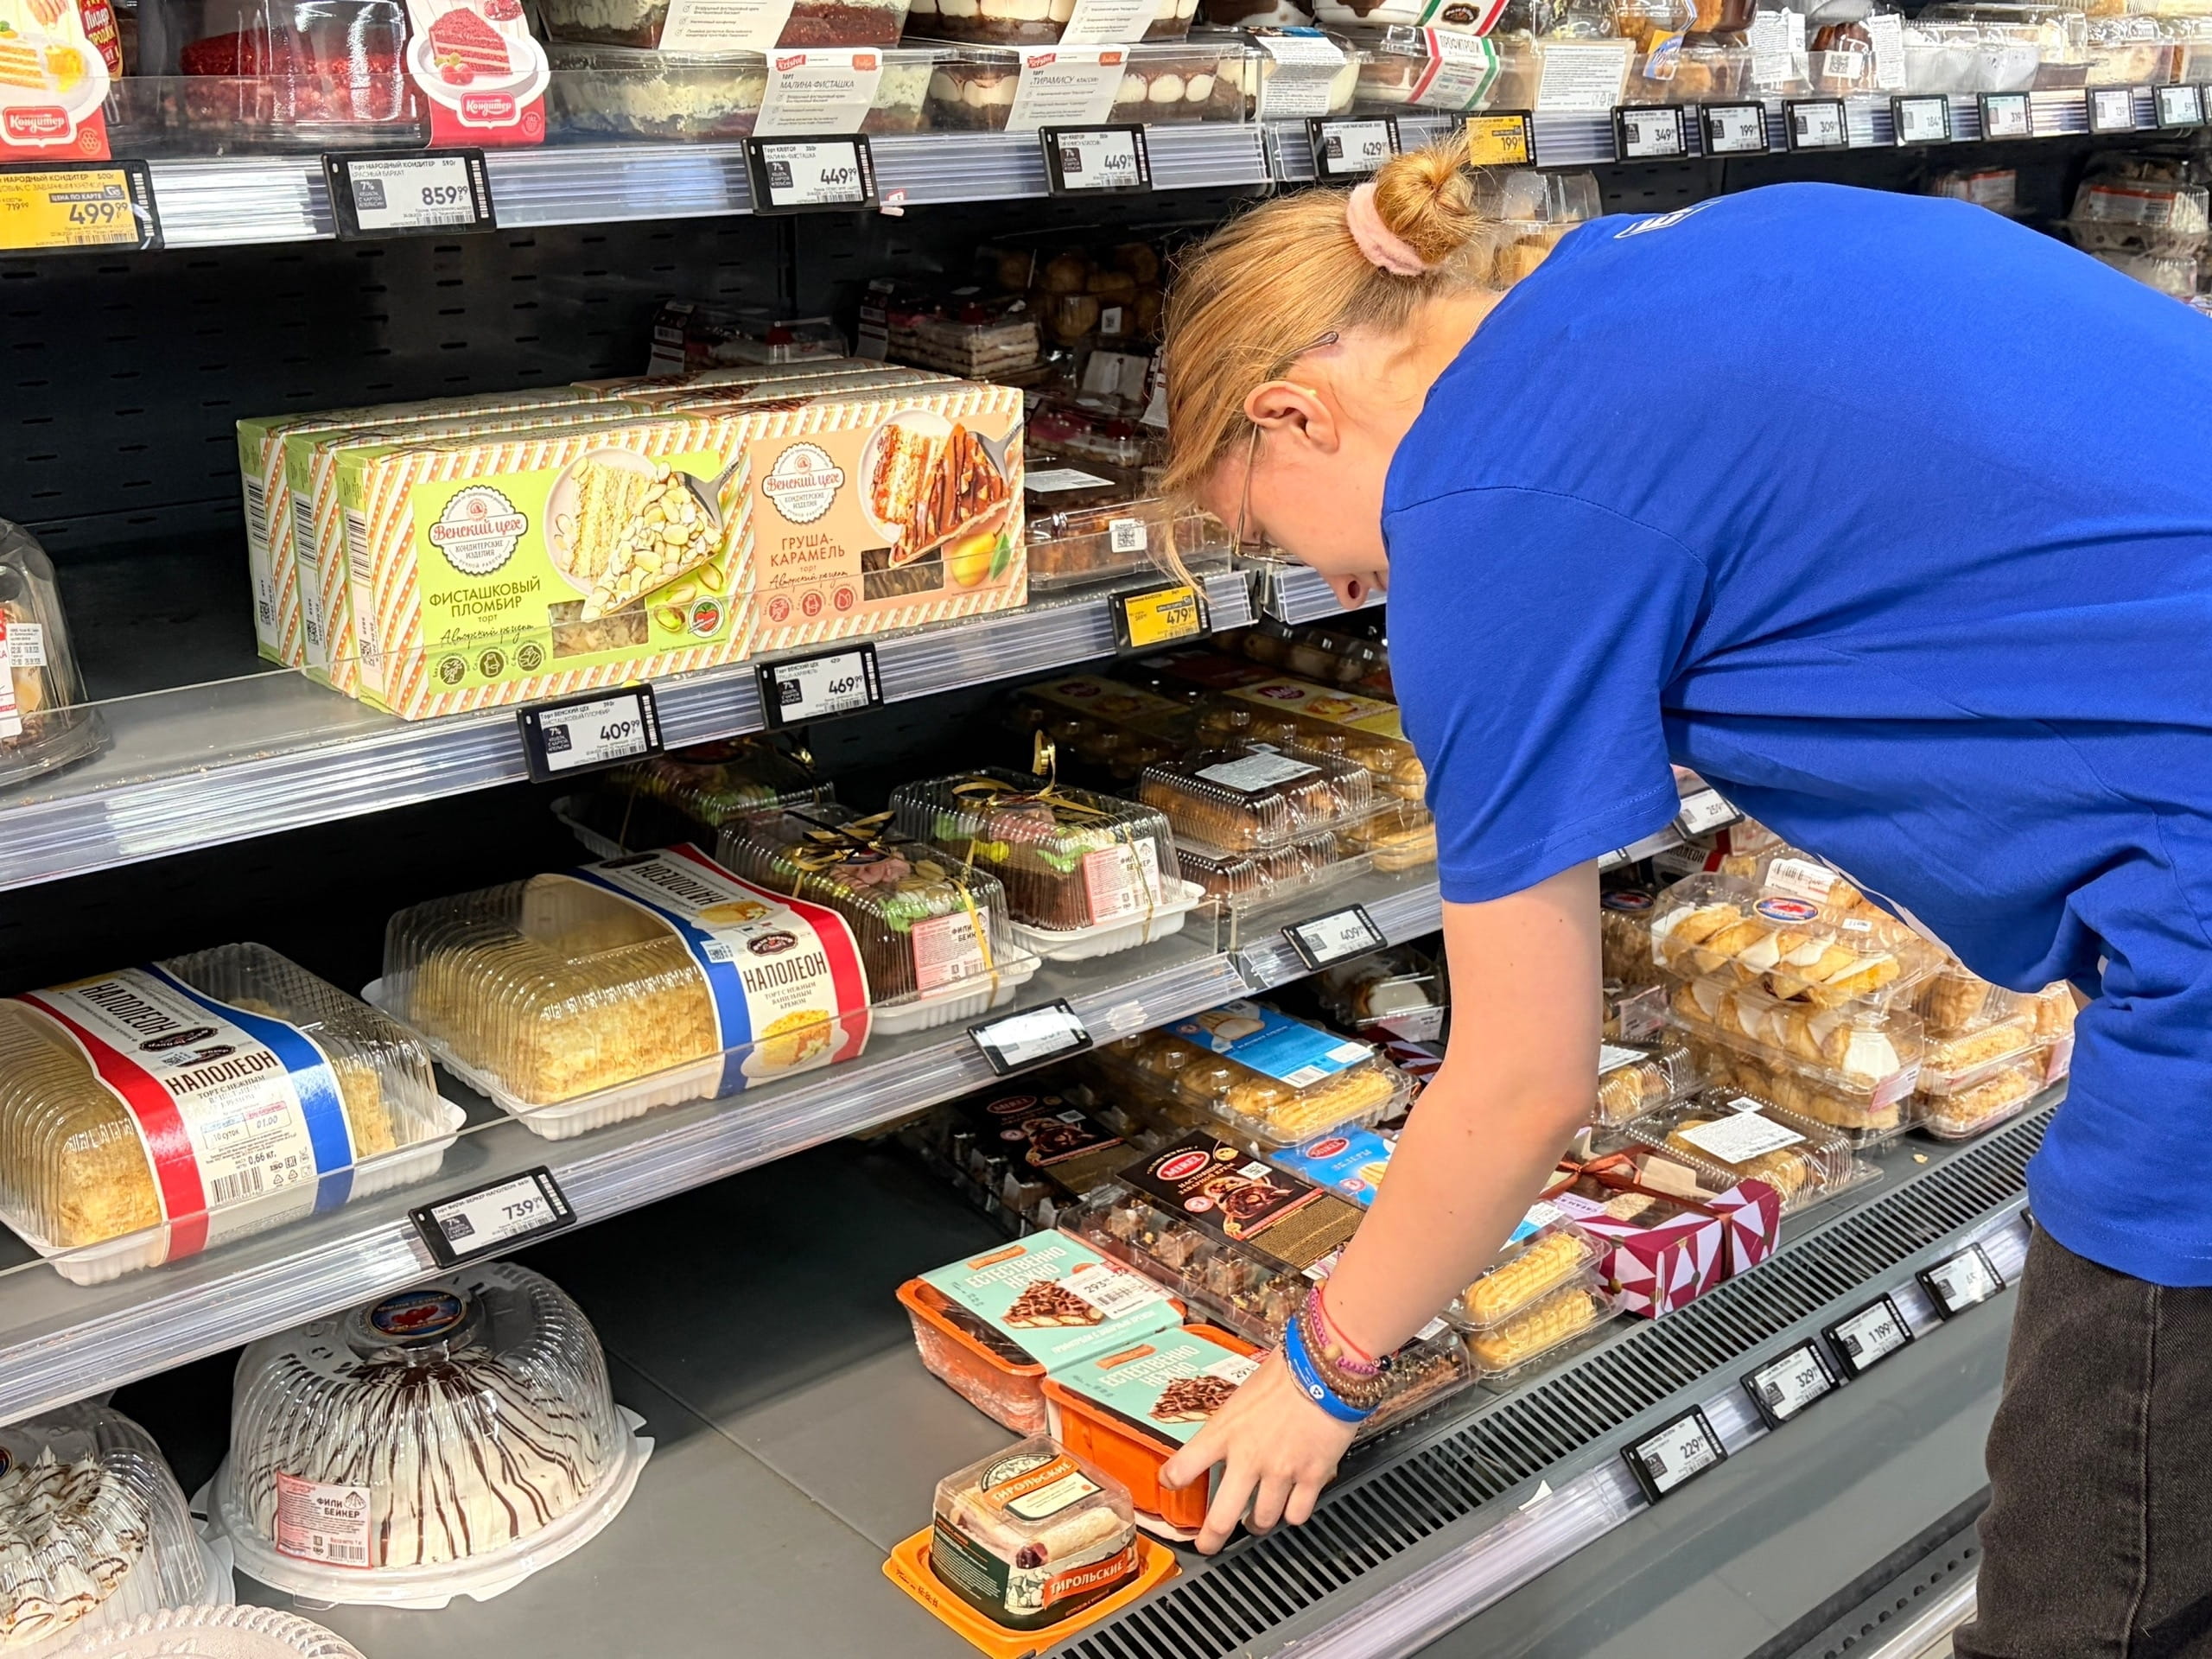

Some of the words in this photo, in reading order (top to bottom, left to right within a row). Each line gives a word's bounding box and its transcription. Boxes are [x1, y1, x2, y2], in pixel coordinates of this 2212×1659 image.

[466, 98, 512, 117] Кондитер
[10, 113, 65, 134] Кондитер
[1363, 142, 1382, 156] 429
[1501, 137, 1518, 151] 199
[1103, 154, 1128, 170] 449
[359, 181, 375, 190] 7%
[820, 168, 849, 185] 449
[421, 185, 457, 206] 859
[457, 186, 468, 194] 99
[69, 203, 115, 225] 499
[115, 202, 129, 212] 99
[766, 472, 817, 493] Венский
[817, 474, 842, 488] цех
[433, 518, 495, 541] Венский
[495, 518, 523, 536] цех
[455, 540, 505, 553] КОНДИТЕРСКИЕ
[781, 532, 834, 550] ГРУША-
[770, 544, 846, 568] КАРАМЕЛЬ
[800, 564, 817, 573] торт
[429, 575, 541, 607] ФИСТАШКОВЫЙ
[450, 595, 523, 618] ПЛОМБИР
[1166, 607, 1189, 625] 479
[478, 613, 499, 624] торт
[829, 677, 855, 695] 469
[549, 727, 562, 736] 7%
[600, 721, 632, 741] 409
[631, 719, 640, 728] 99
[631, 862, 729, 906] НАПОЛЕОН
[1339, 927, 1361, 941] 409
[742, 950, 828, 995] НАПОЛЕОН
[78, 982, 182, 1036] НАПОЛЕОН
[164, 1050, 280, 1096] НАПОЛЕОН
[247, 1152, 266, 1166] 0,66
[1162, 1155, 1205, 1178] MIREL
[501, 1198, 534, 1221] 739
[964, 1246, 1068, 1289] ЕСТЕСТВЕННО
[1000, 1262, 1062, 1290] НЕЖНО
[1084, 1281, 1107, 1294] 293
[1097, 1344, 1201, 1388] ЕСТЕСТВЕННО
[1137, 1362, 1200, 1389] НЕЖНО
[1795, 1368, 1815, 1389] 329
[1680, 1438, 1700, 1459] 229
[992, 1460, 1073, 1503] ТИРОЛЬСКИЕ
[316, 1497, 343, 1509] ФИЛИ
[324, 1507, 360, 1519] БЕЙКЕР
[1049, 1560, 1123, 1596] ТИРОЛЬСКИЕ
